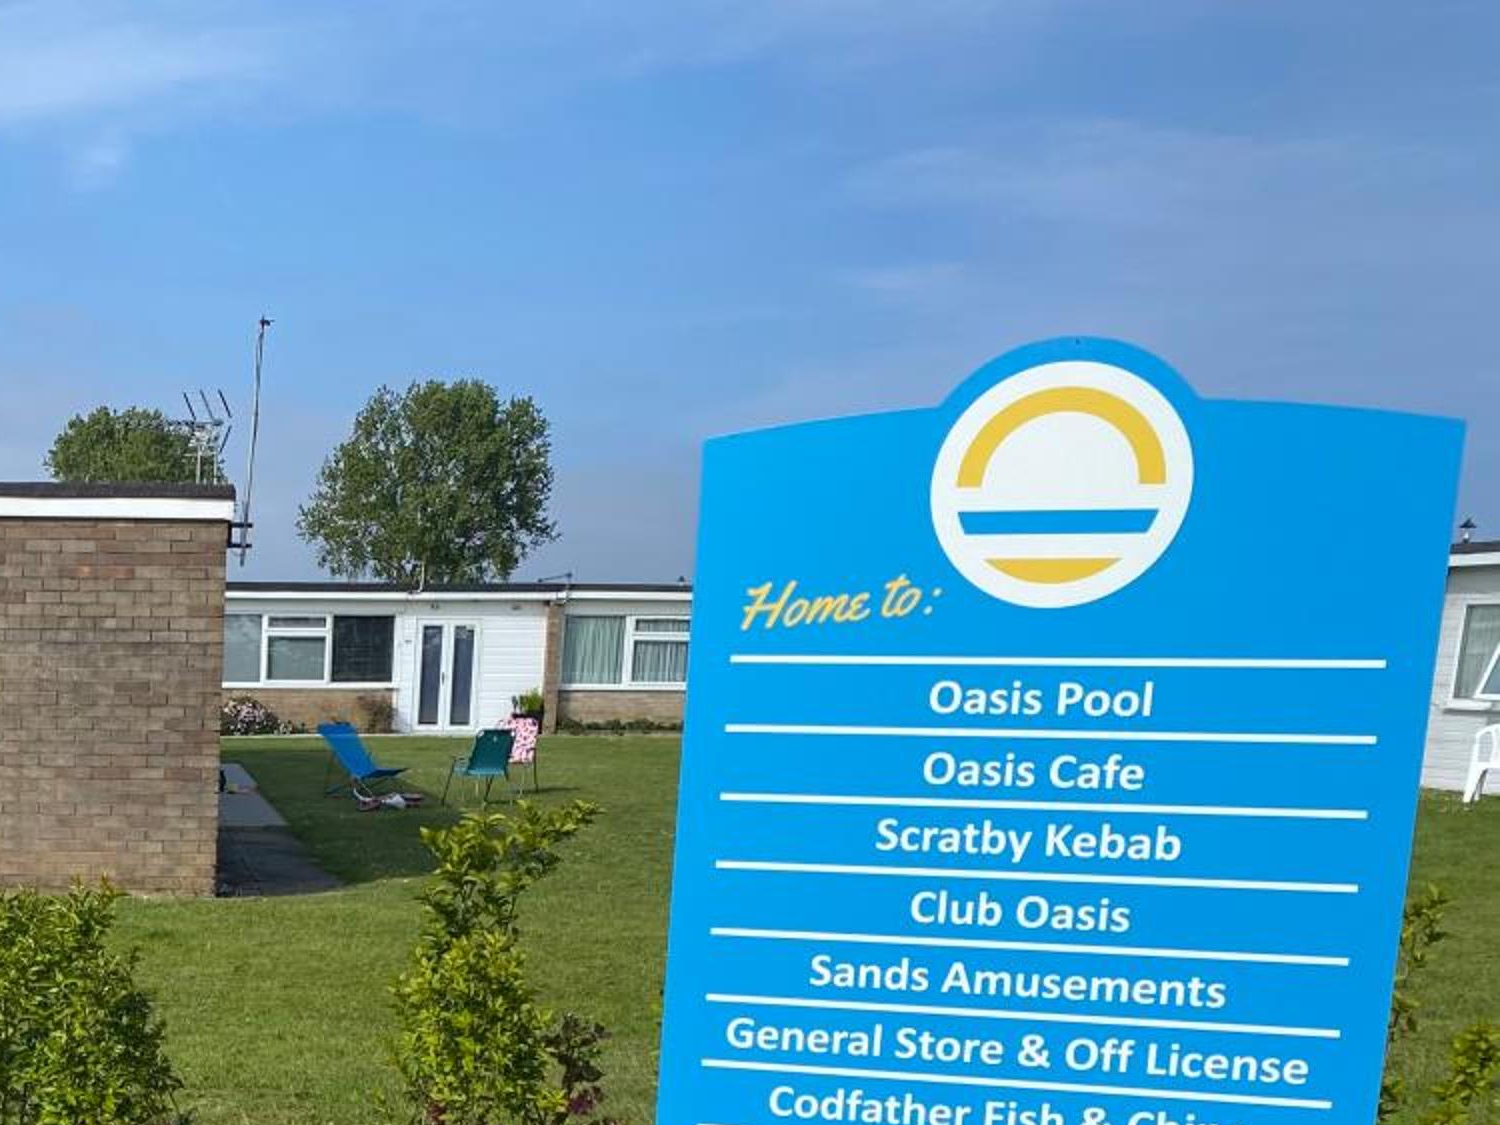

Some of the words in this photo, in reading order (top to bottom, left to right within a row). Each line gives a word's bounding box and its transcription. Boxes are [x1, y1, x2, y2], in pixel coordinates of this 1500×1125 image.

[741, 580, 871, 631] Home
[880, 575, 941, 618] to:
[929, 680, 1042, 715] Oasis
[1057, 681, 1154, 717] Pool
[923, 751, 1035, 787] Oasis
[1049, 753, 1145, 790] Cafe
[875, 818, 1033, 863] Scratby
[1045, 823, 1181, 861] Kebab
[911, 890, 1003, 927] Club
[1016, 895, 1130, 933] Oasis
[809, 954, 929, 992] Sands
[941, 961, 1226, 1009] Amusements
[726, 1017, 883, 1057] General
[894, 1027, 1004, 1065] Store
[1017, 1034, 1050, 1068] &
[1065, 1038, 1135, 1073] Off
[1146, 1043, 1309, 1085] License
